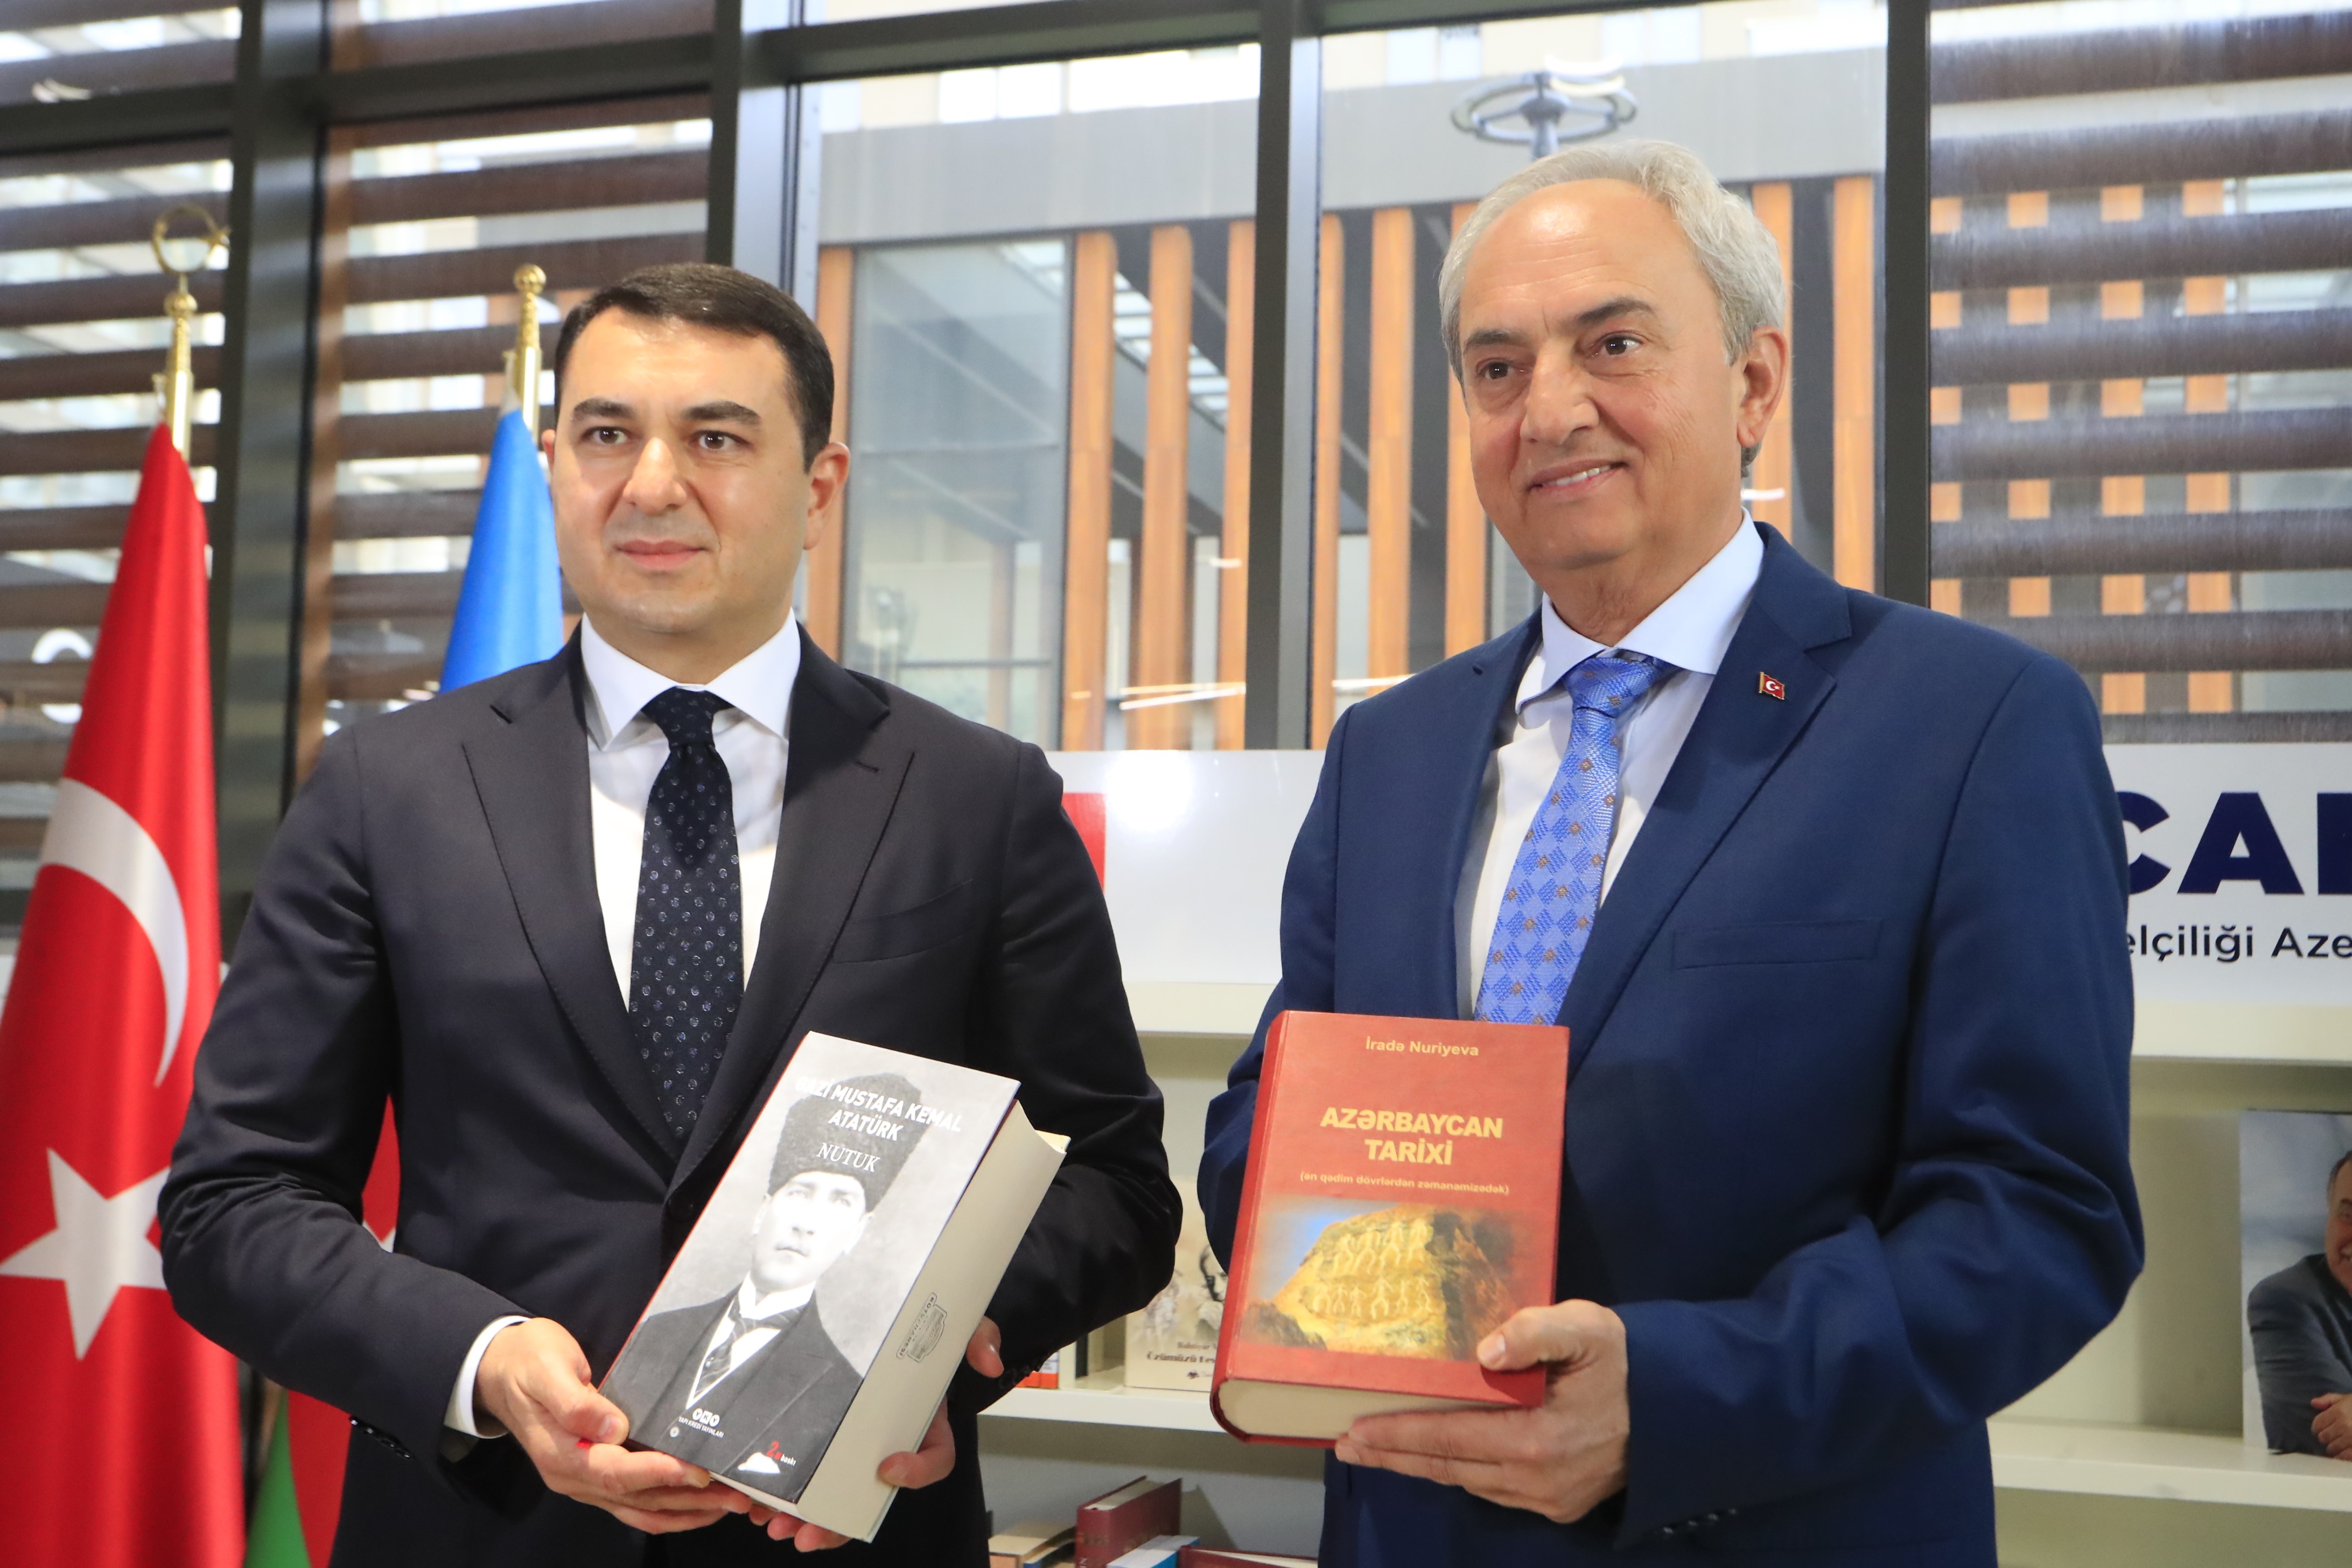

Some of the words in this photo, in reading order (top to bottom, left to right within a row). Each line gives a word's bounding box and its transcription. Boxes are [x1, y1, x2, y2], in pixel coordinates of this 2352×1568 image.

[1366, 1035, 1405, 1052] İradə
[1409, 1041, 1479, 1057] Nuriyeva
[830, 1084, 905, 1117] MUSTAFA
[904, 1102, 963, 1132] KEMAL
[828, 1109, 904, 1141] ATATÜRK
[1320, 1107, 1503, 1139] AZƏRBAYCAN
[816, 1142, 881, 1173] NUTUK
[1364, 1138, 1453, 1165] TARİXİ
[1320, 1173, 1353, 1184] qədim
[678, 1416, 688, 1425] YAPI
[687, 1418, 702, 1431] KREDİ
[701, 1425, 725, 1438] YAYINLARI
